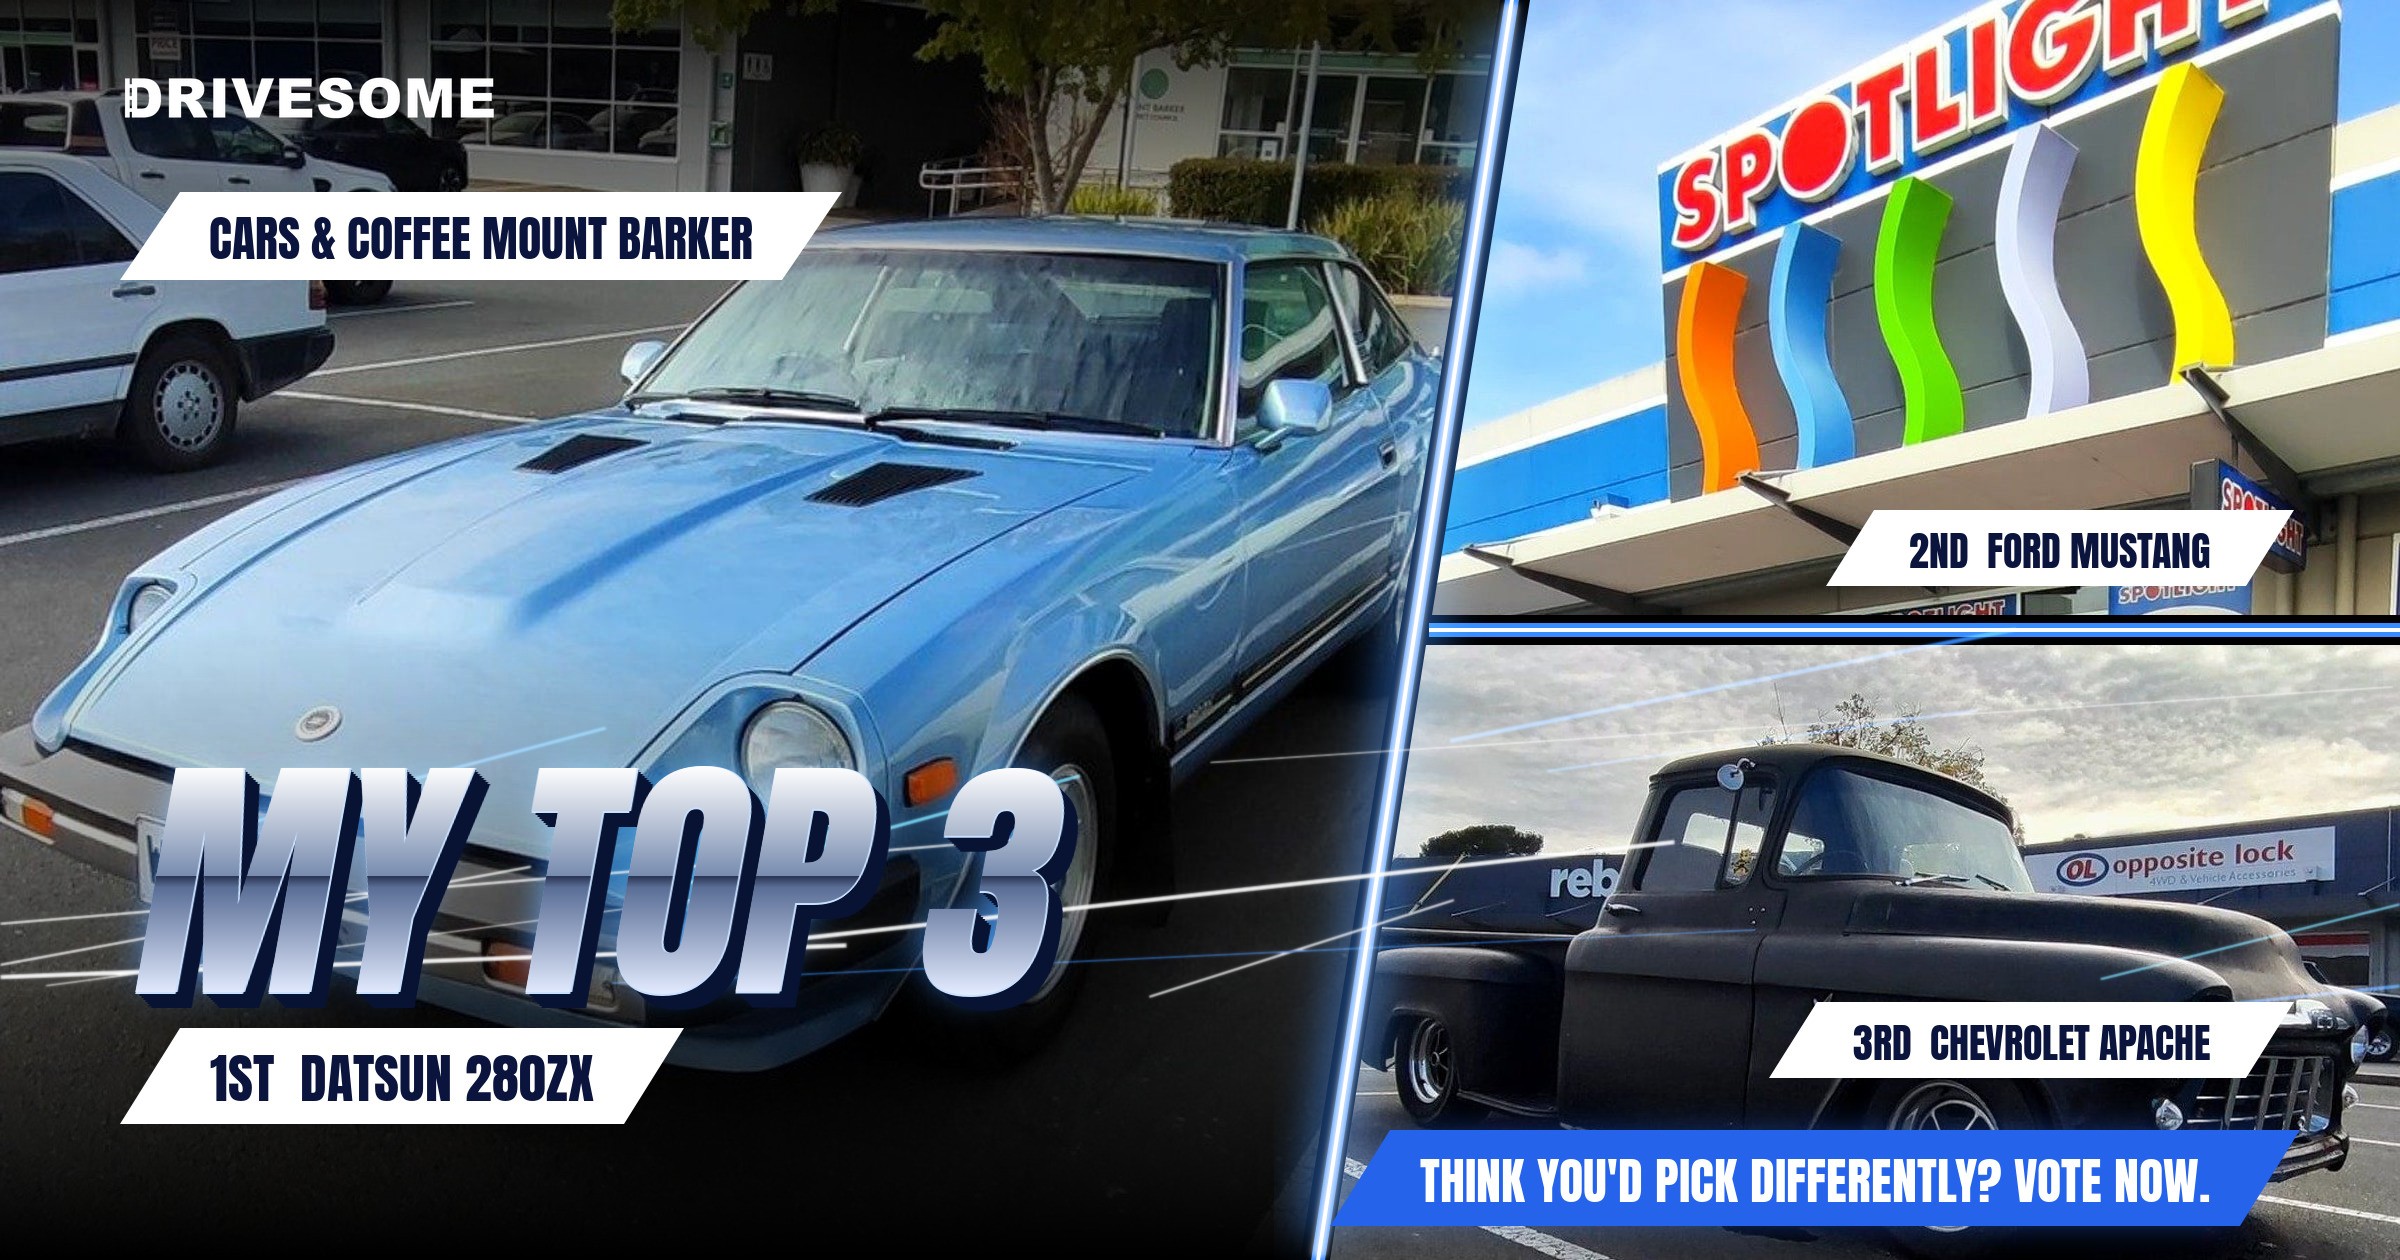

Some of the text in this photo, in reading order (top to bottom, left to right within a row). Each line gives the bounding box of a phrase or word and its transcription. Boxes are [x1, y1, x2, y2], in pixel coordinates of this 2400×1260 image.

[1671, 0, 2270, 251] SPOTLIGH
[2066, 839, 2294, 880] OL opposite lock
[2149, 868, 2296, 886] 4WD & Vehicle Accessories
